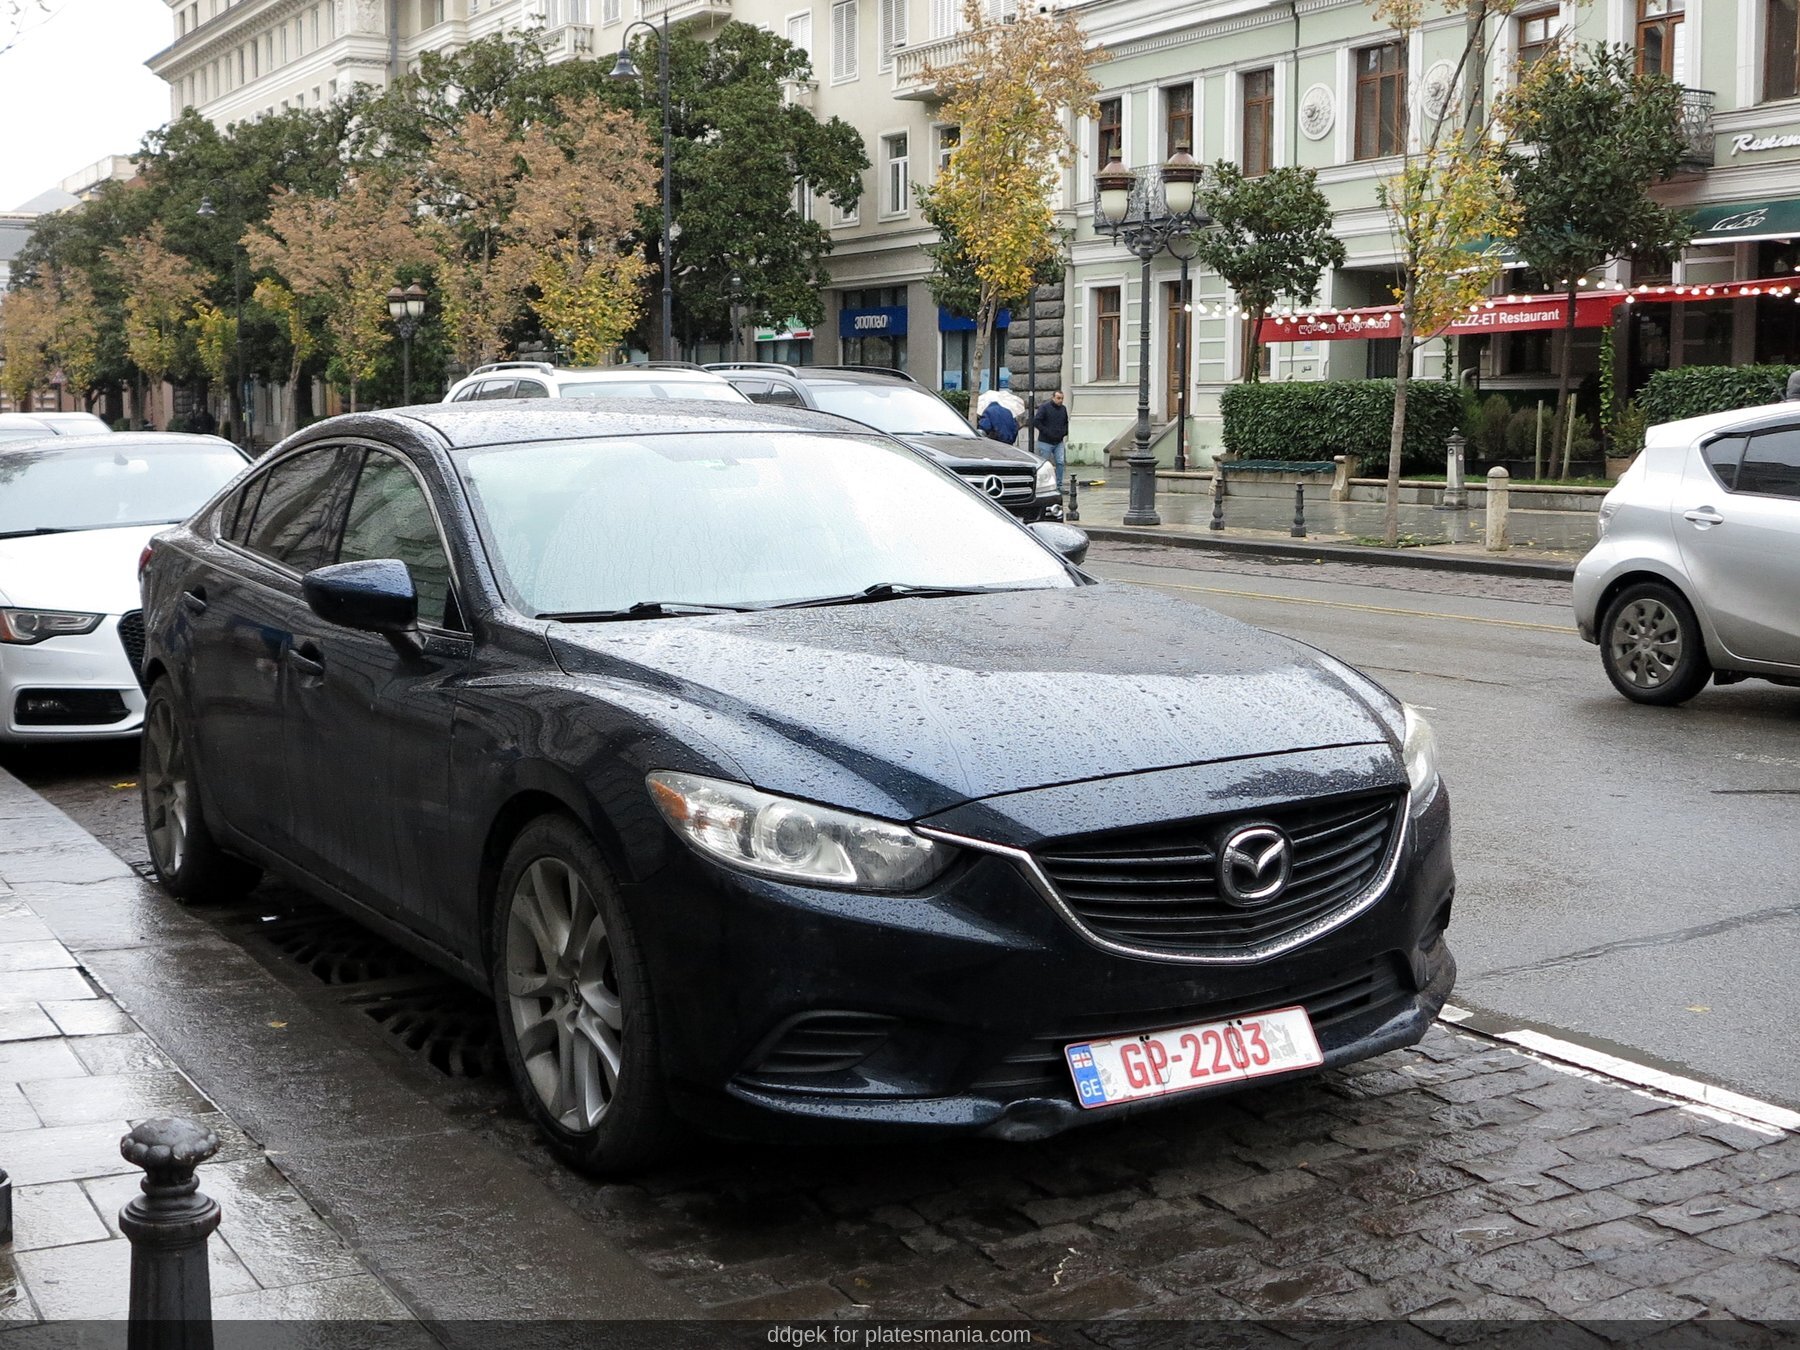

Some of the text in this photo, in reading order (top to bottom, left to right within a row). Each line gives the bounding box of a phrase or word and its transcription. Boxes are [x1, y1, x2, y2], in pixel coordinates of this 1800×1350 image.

[1338, 318, 1390, 332] რესტოანი
[1499, 308, 1560, 324] Restaurant
[1119, 1022, 1271, 1090] GP-2203
[1079, 1077, 1103, 1098] GE
